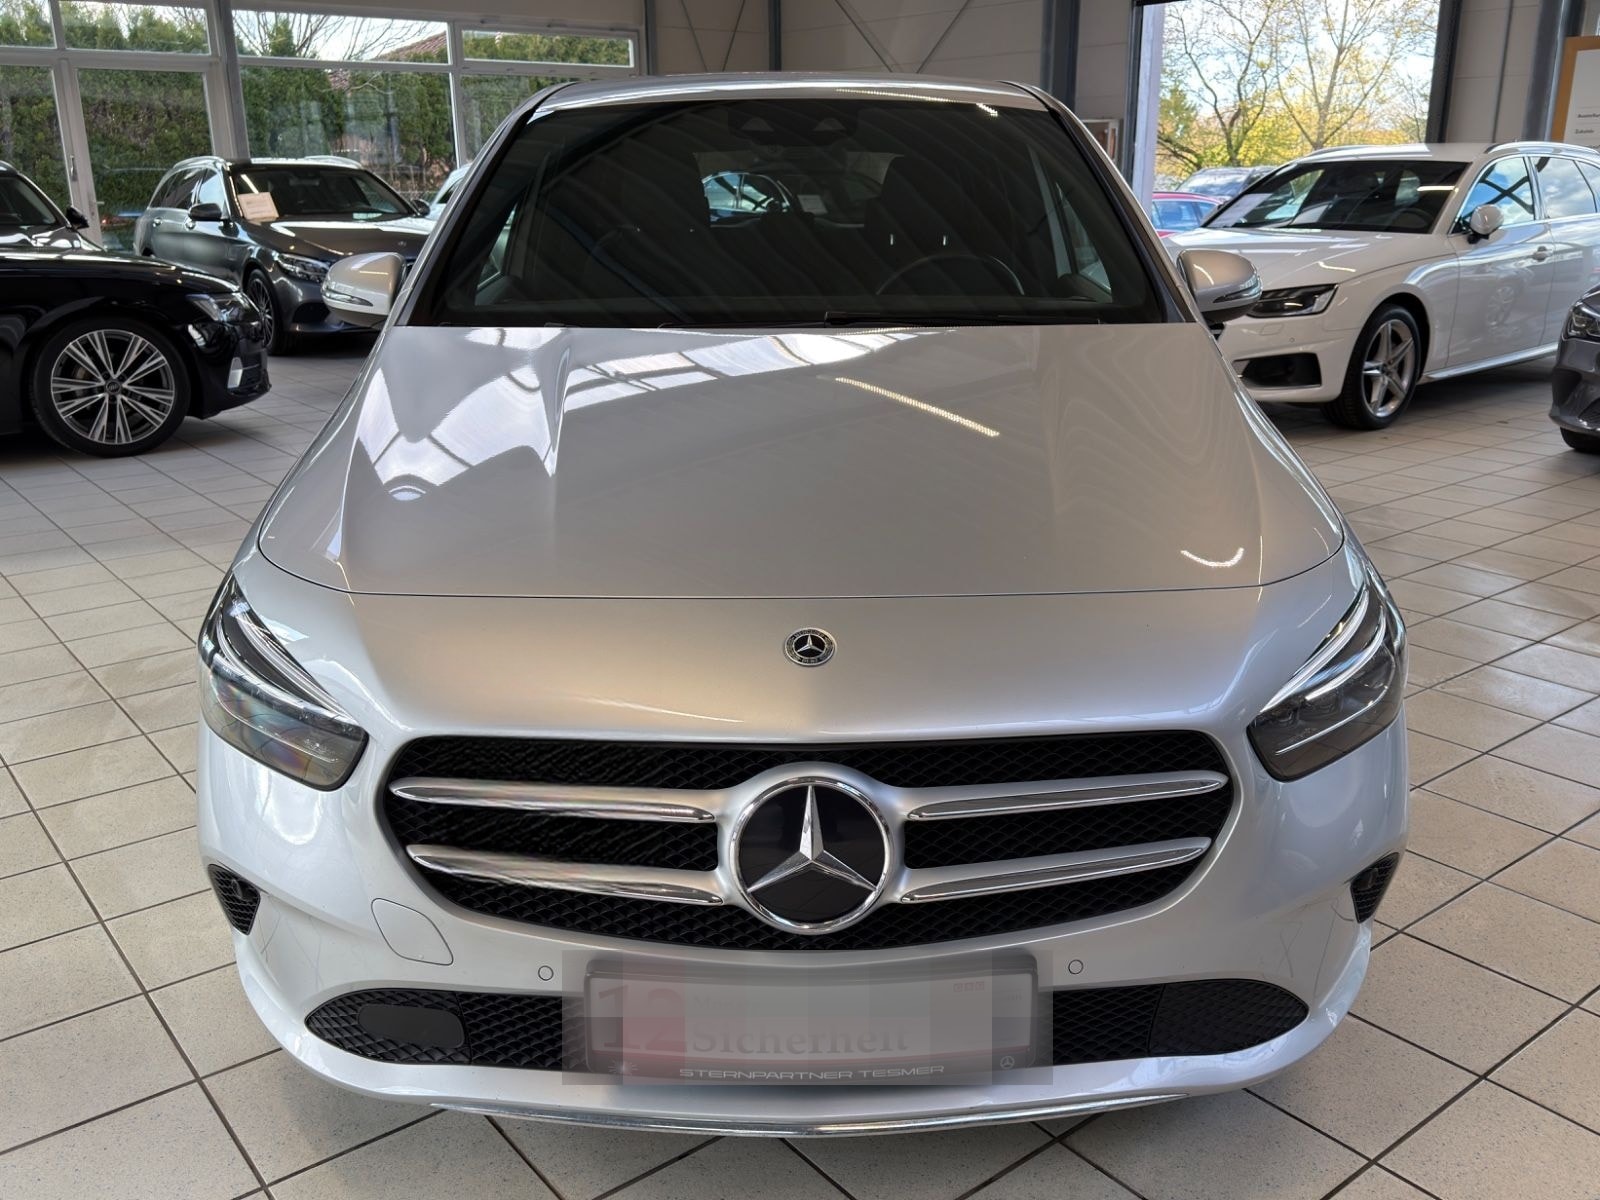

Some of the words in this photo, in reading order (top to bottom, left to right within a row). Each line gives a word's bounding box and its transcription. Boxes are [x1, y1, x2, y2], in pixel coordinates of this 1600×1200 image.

[598, 985, 687, 1052] 12
[693, 1020, 909, 1054] Sicherheit
[679, 1068, 853, 1081] STERNPARTNER
[858, 1065, 945, 1079] TESMER
